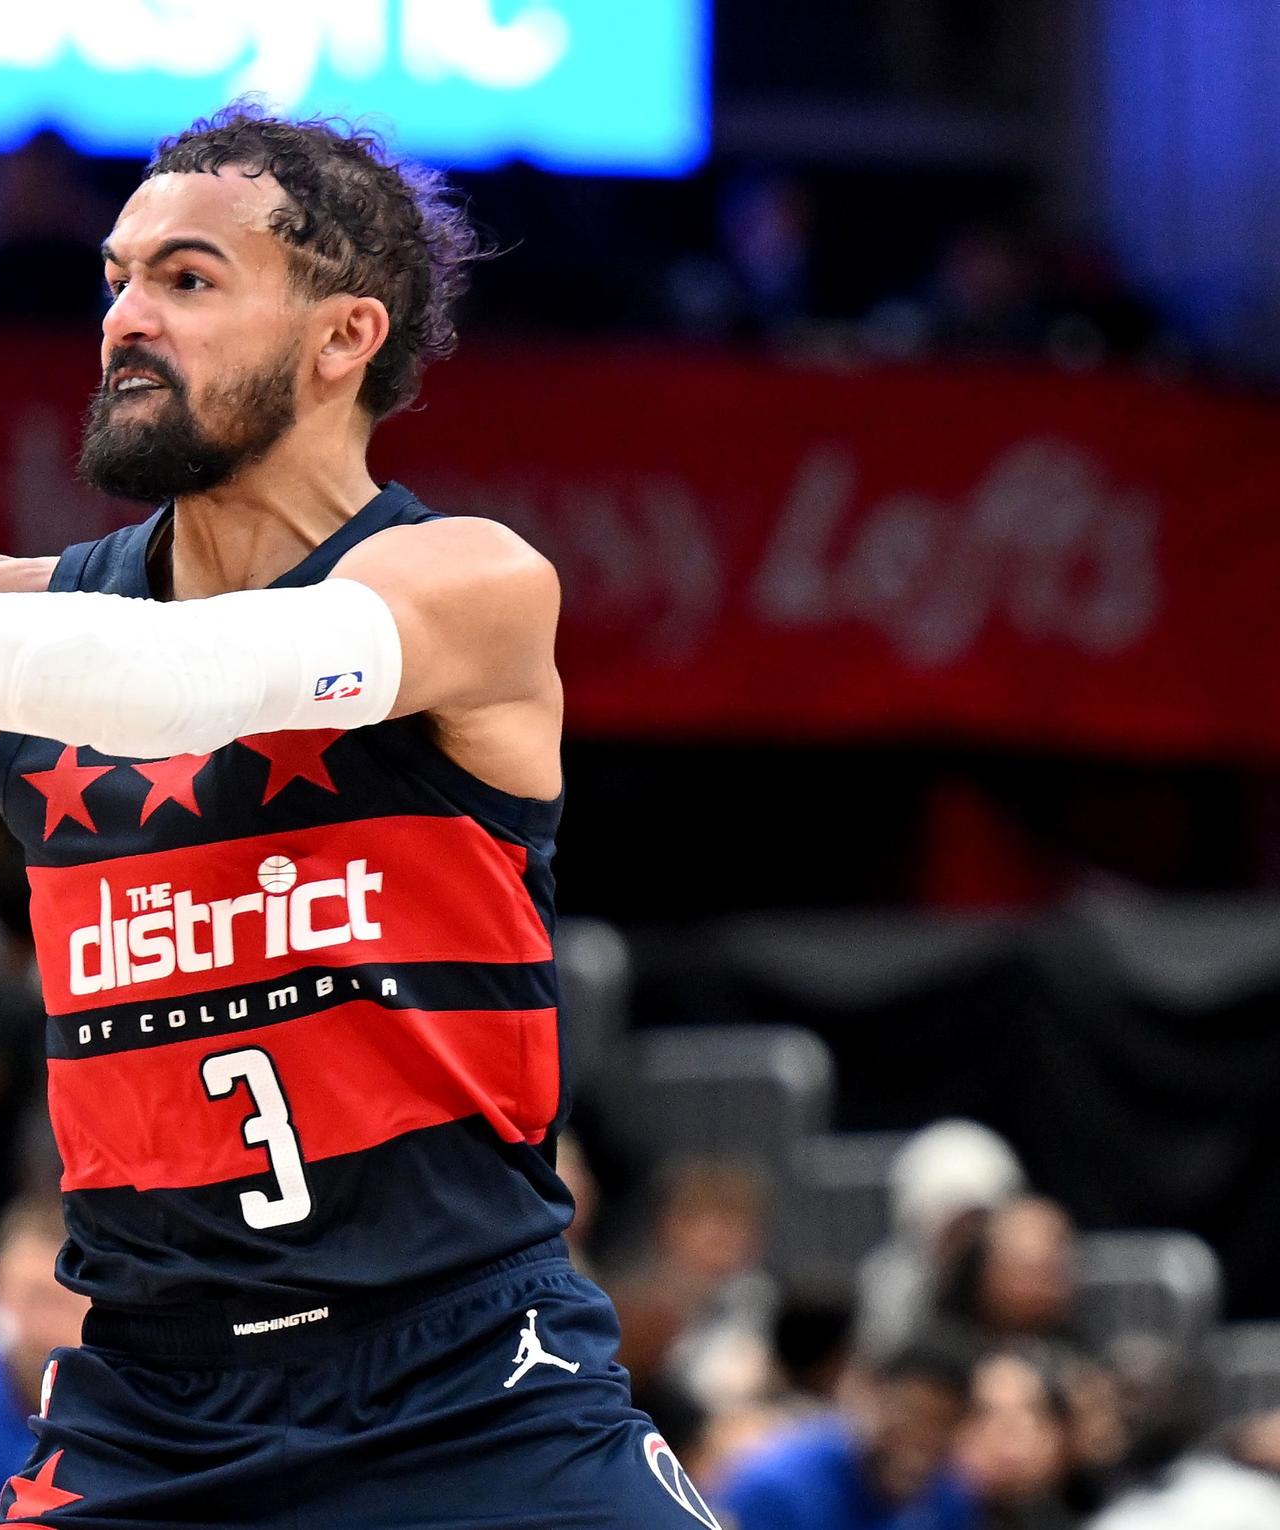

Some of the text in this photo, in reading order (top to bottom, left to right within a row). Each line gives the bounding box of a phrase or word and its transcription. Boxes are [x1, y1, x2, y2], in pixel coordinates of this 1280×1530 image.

[126, 883, 171, 912] THE
[78, 1020, 113, 1046] OF
[201, 1048, 311, 1229] 3
[233, 1307, 329, 1336] WASHINGTON
